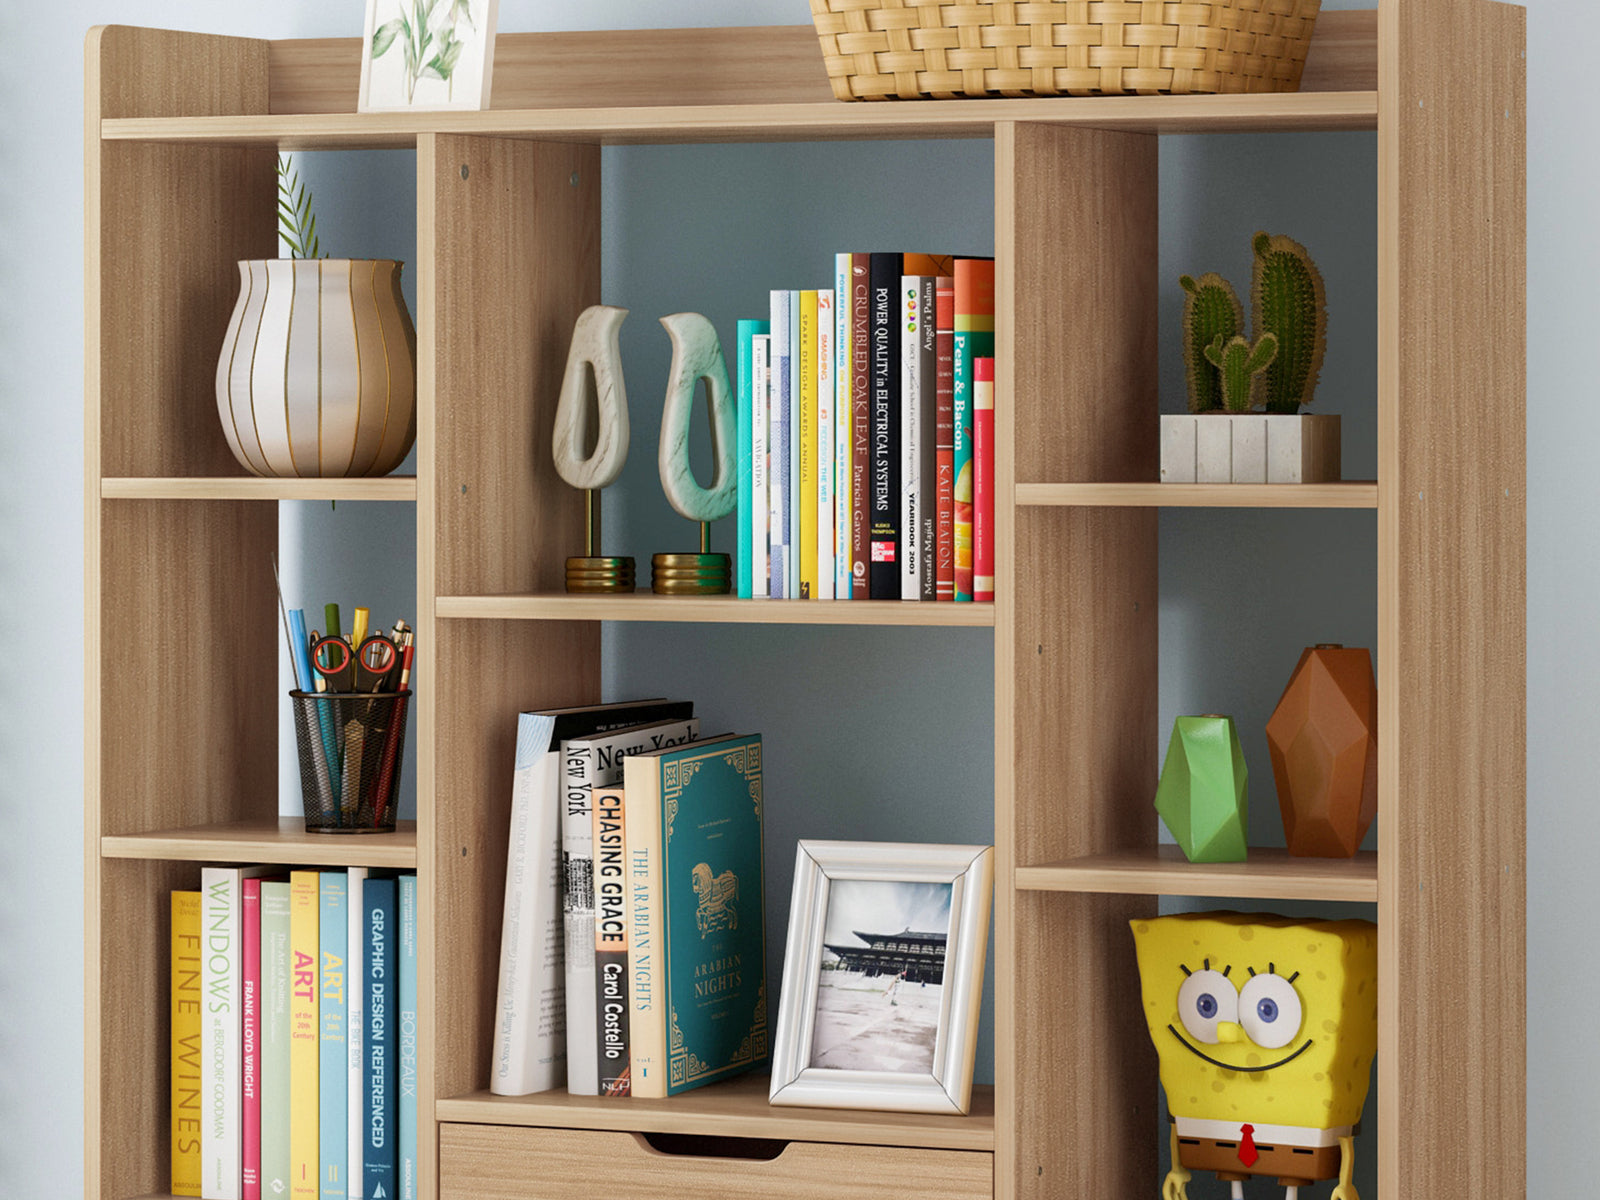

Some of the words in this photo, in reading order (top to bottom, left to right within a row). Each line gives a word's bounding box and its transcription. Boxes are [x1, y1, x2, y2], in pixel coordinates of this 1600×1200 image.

[876, 288, 888, 325] POWER
[924, 282, 932, 314] Psalms
[855, 284, 867, 372] CRUMBLED
[820, 333, 828, 381] SMASHING
[874, 327, 888, 376] QUALITY
[954, 336, 965, 376] Pear
[855, 375, 867, 412] OAK
[876, 377, 886, 387] in
[954, 380, 965, 395] &
[856, 415, 867, 456] LEAF
[876, 389, 888, 458] ELECTRICAL
[954, 400, 965, 451] Bacon
[820, 467, 828, 483] THE
[820, 484, 828, 503] WEB
[854, 464, 864, 508] Patricia
[876, 460, 888, 511] SYSTEMS
[939, 464, 950, 505] KATE
[854, 510, 864, 552] Gavros
[924, 518, 933, 552] Majidi
[939, 511, 950, 569] BEATON
[924, 553, 933, 594] Mostafa
[567, 747, 591, 778] New
[597, 744, 644, 771] New
[567, 783, 593, 816] York
[599, 795, 622, 877] CHASING
[632, 848, 648, 878] THE
[601, 882, 623, 942] GRACE
[634, 883, 650, 949] ARABIAN
[208, 880, 230, 1013] WINDOWS
[372, 908, 384, 979] GRAPHIC
[178, 934, 200, 1014] FINE
[278, 967, 285, 977] of
[294, 950, 314, 1003] ART
[323, 951, 343, 1005] ART
[603, 963, 623, 1000] Carol
[635, 954, 651, 1012] NIGHTS
[694, 953, 742, 978] ARABIAN
[694, 970, 743, 999] NIGHTS
[244, 980, 253, 1016] FRANK
[277, 978, 286, 1014] Knitting
[372, 983, 384, 1041] DESIGN
[214, 1017, 221, 1026] at
[244, 1017, 253, 1053] LLOYD
[292, 1031, 315, 1041] Century
[297, 1021, 311, 1030] 20th
[321, 1033, 345, 1043] Century
[351, 1028, 360, 1046] BIKE
[352, 1010, 360, 1026] THE
[604, 1003, 624, 1059] Costello
[214, 1028, 224, 1082] BERGDORF
[401, 1010, 415, 1097] BORDEAUX
[178, 1034, 200, 1154] WINES
[244, 1055, 253, 1099] WRIGHT
[371, 1045, 384, 1148] REFERENCED
[214, 1084, 224, 1140] GOODMAN
